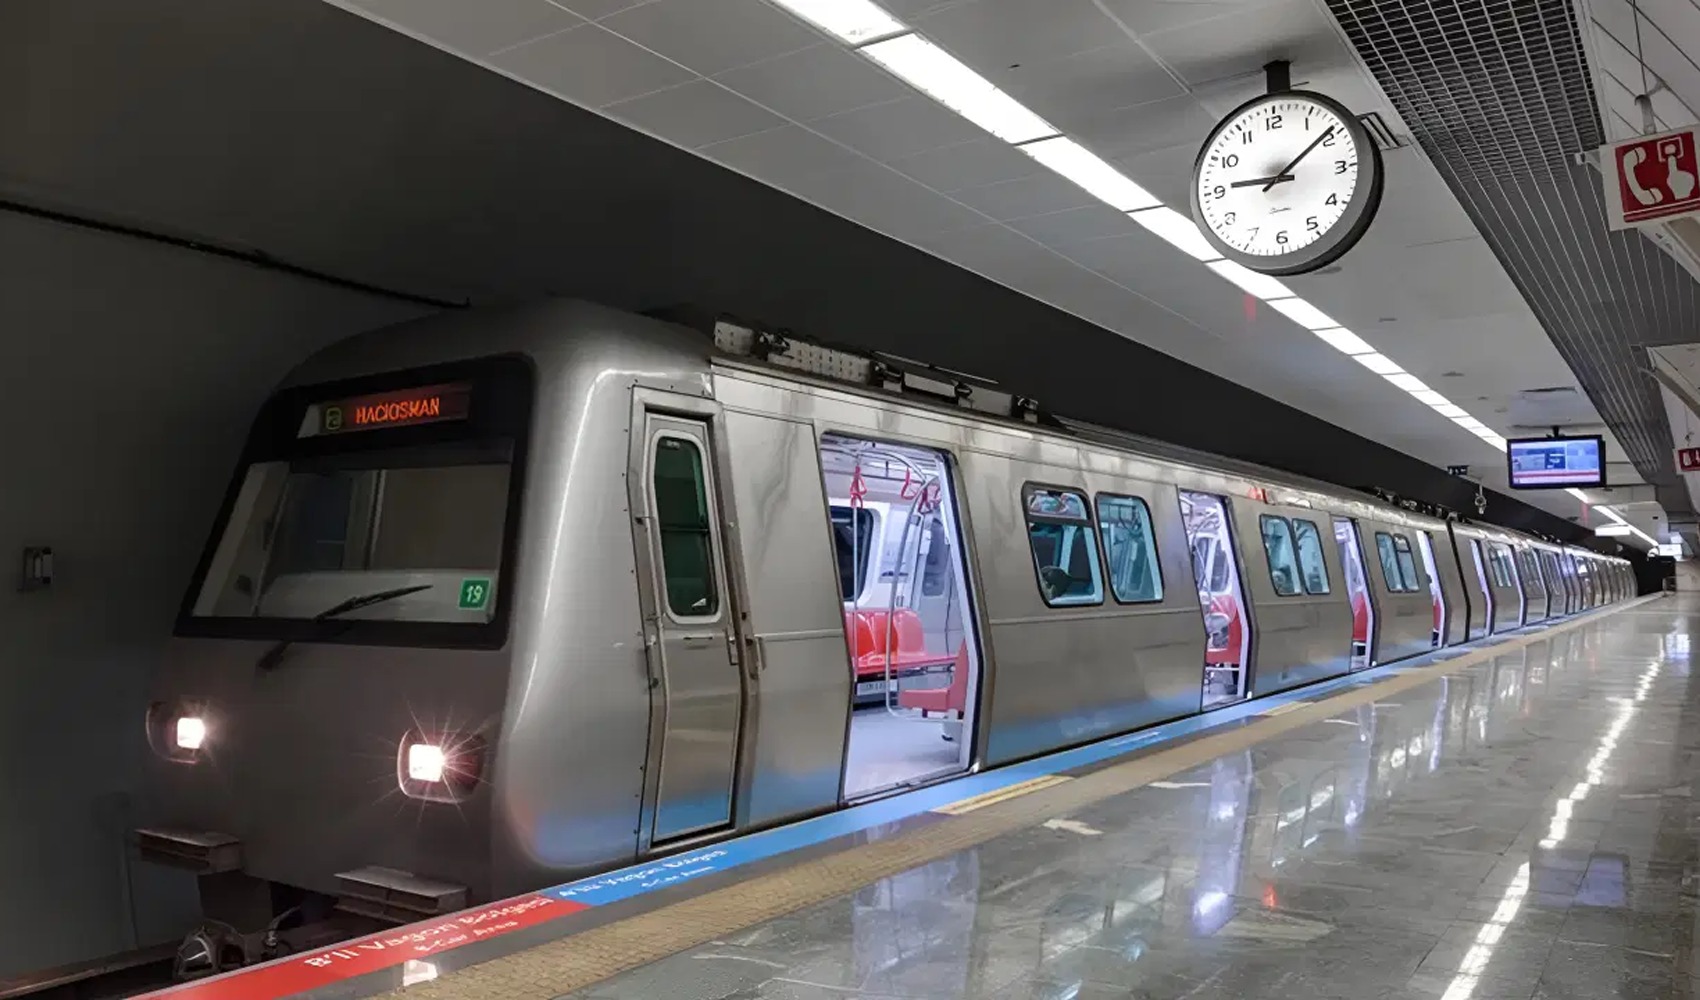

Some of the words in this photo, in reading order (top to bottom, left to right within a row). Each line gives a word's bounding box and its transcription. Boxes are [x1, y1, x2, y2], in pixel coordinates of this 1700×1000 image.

[1265, 115, 1283, 131] 12
[1304, 117, 1310, 131] 1
[1242, 130, 1253, 145] 11
[1322, 132, 1336, 147] 2
[1221, 153, 1239, 169] 10
[1334, 160, 1347, 175] 3
[1213, 185, 1226, 200] 9
[1324, 192, 1338, 206] 4
[1306, 216, 1319, 231] 5
[1247, 227, 1260, 241] 7
[1275, 230, 1289, 244] 6
[466, 585, 484, 603] 19
